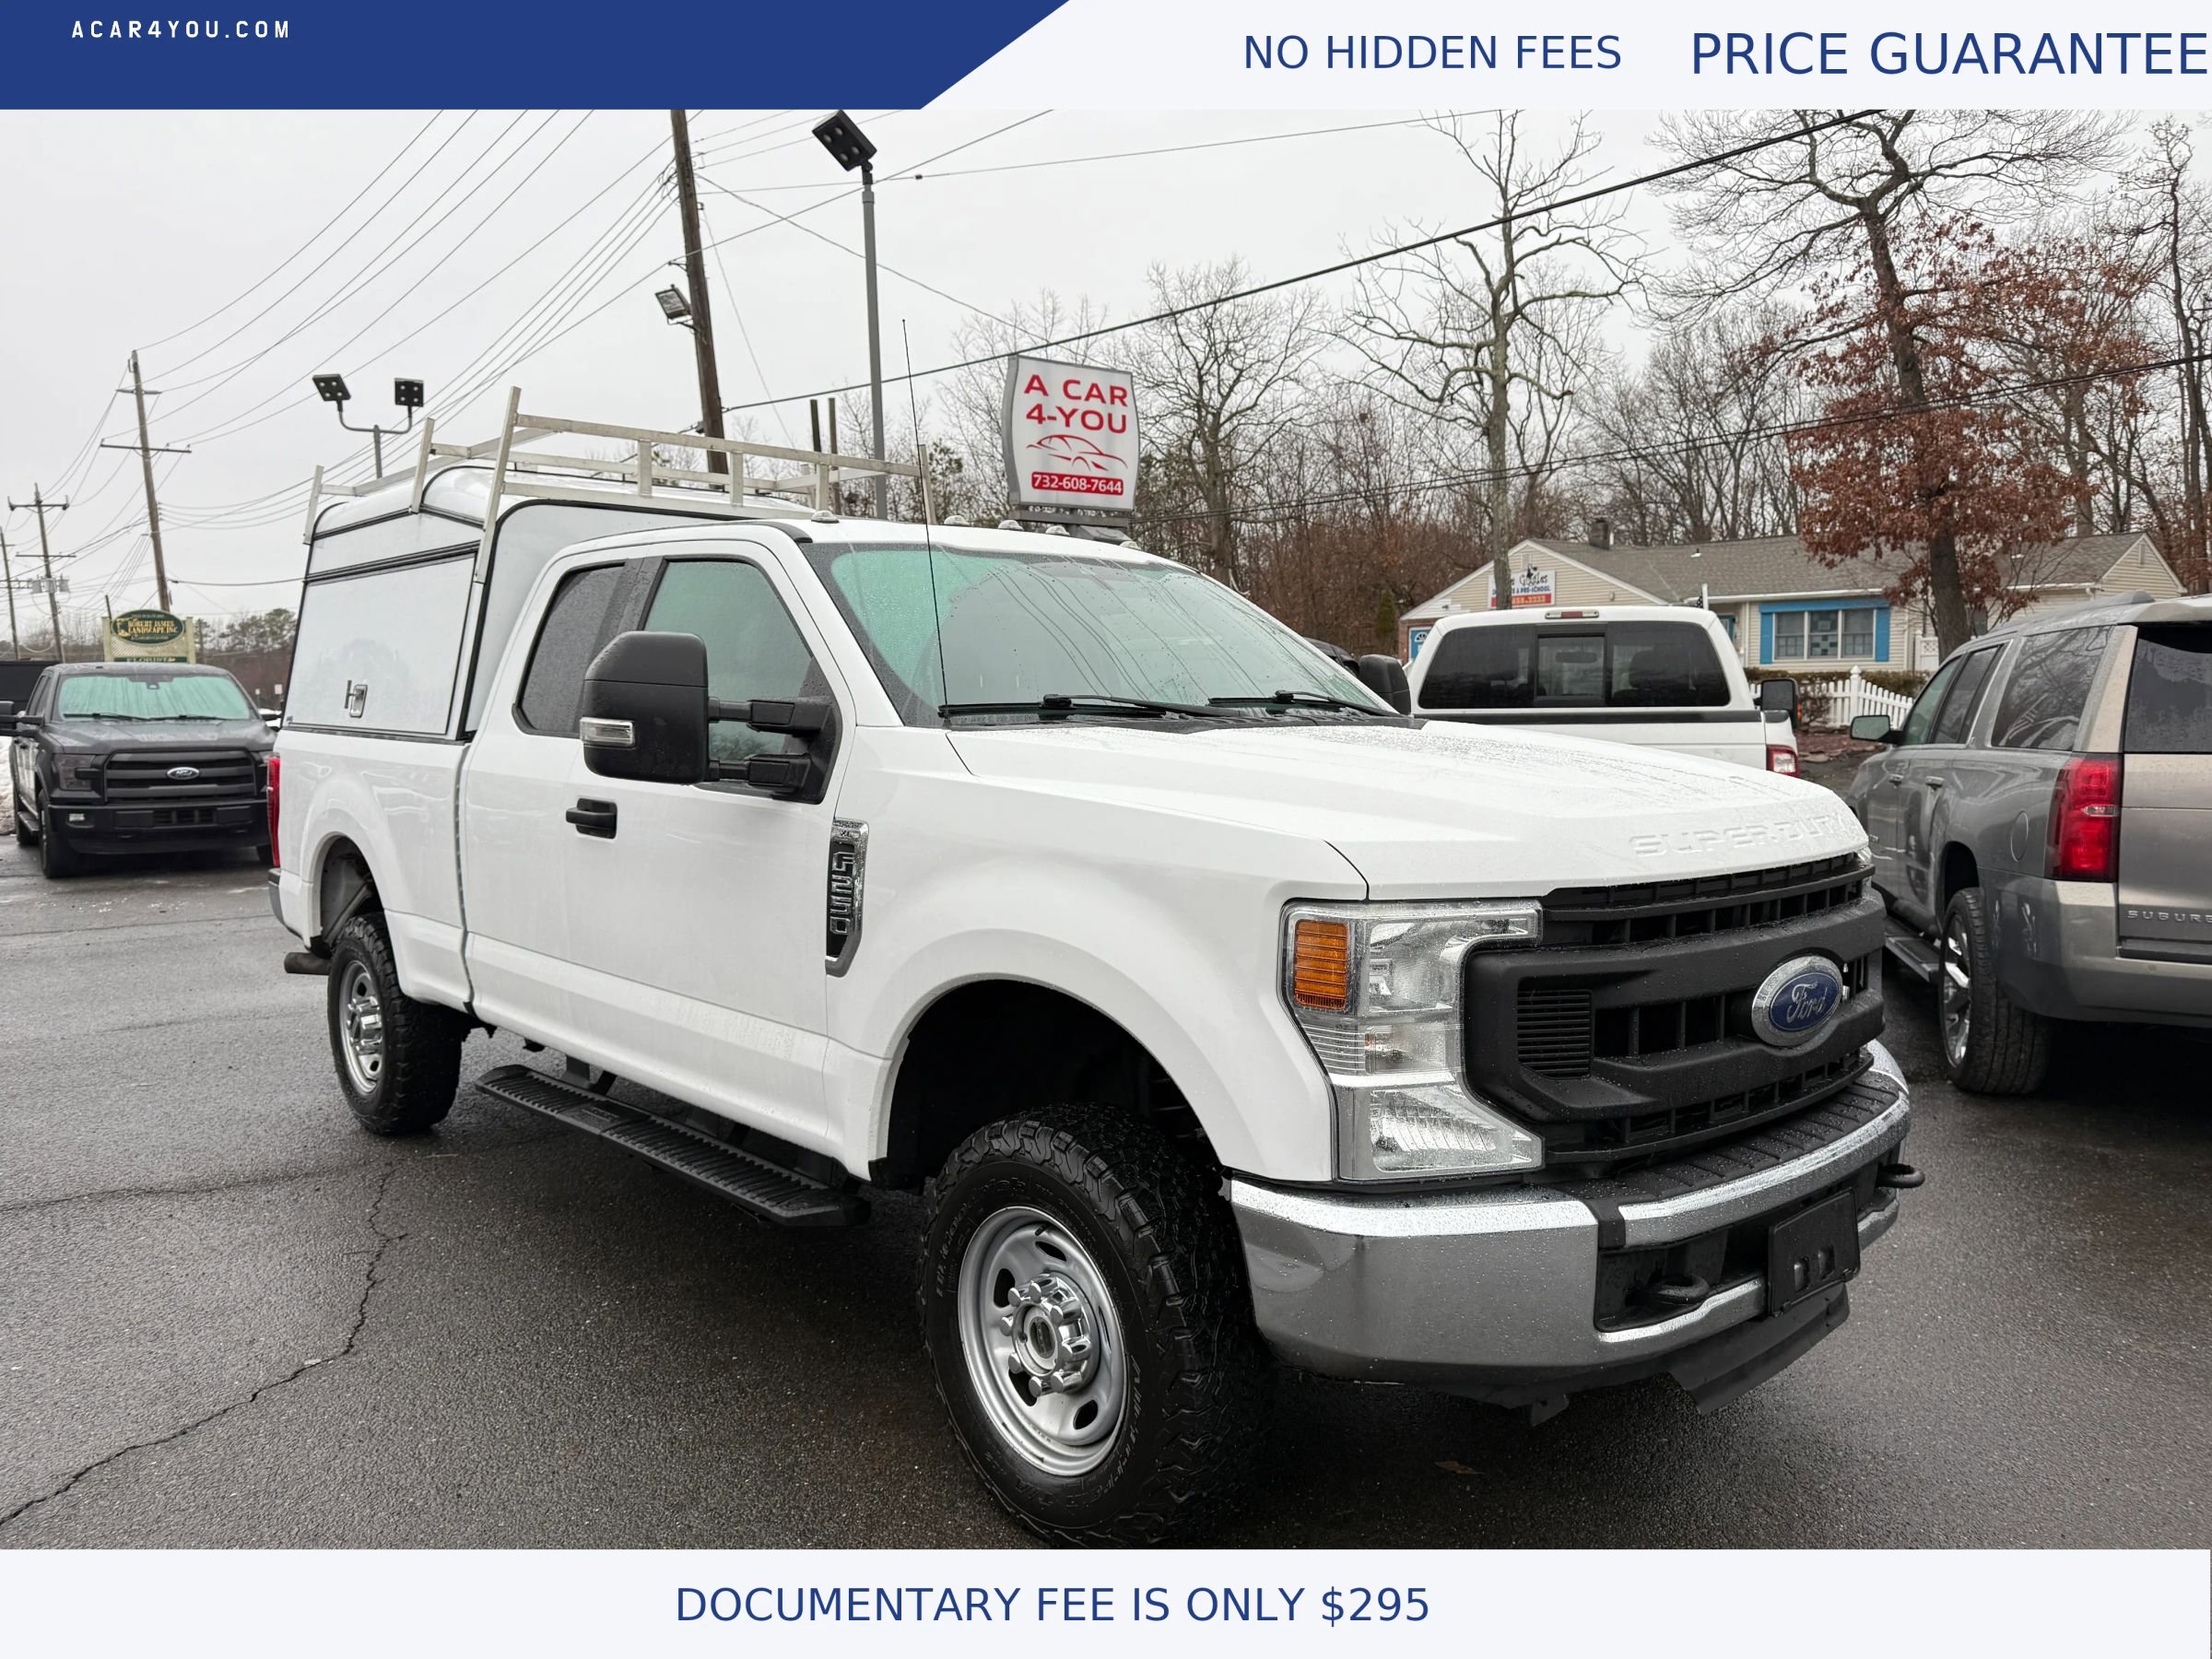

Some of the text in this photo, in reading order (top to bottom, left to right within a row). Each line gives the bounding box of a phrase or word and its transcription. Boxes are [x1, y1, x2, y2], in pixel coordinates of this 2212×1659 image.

[1024, 374, 1128, 406] A CAR
[1026, 403, 1126, 433] 4-YOU
[1032, 474, 1123, 493] 732-608-7644
[1786, 981, 1829, 1023] Ford
